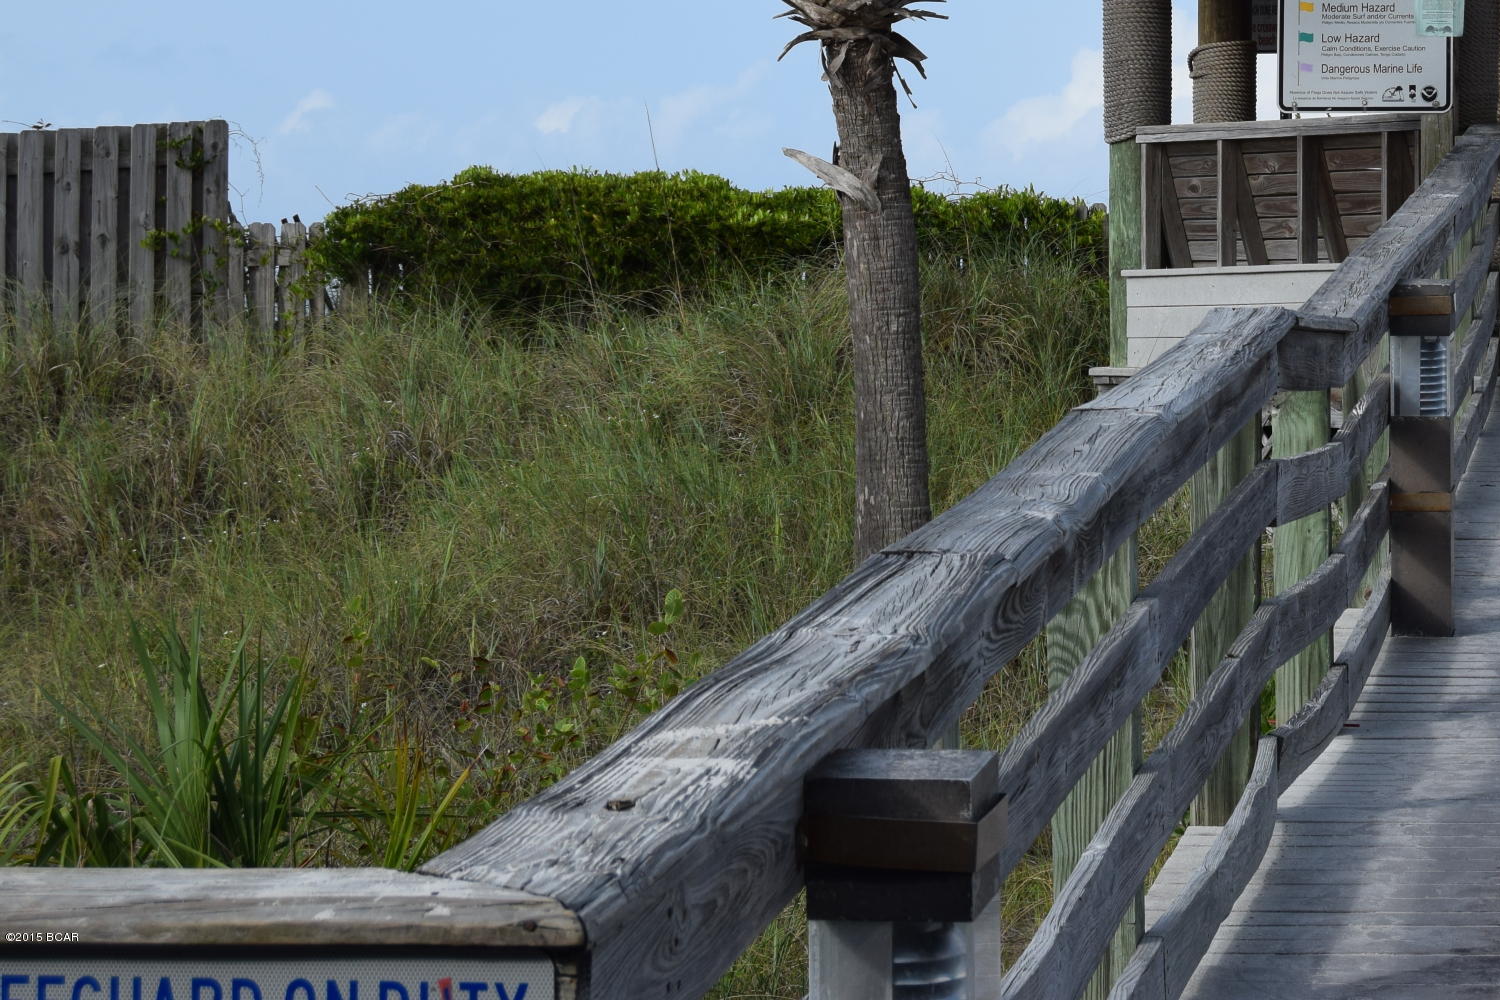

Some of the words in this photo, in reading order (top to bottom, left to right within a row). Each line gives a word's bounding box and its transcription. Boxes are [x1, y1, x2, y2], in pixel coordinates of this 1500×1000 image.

[1321, 2, 1359, 13] Medium
[1361, 2, 1396, 13] Hazard
[1321, 33, 1342, 43] Low
[1344, 33, 1380, 43] Hazard
[1321, 63, 1370, 76] Dangerous
[1373, 63, 1404, 74] Marine
[1406, 63, 1423, 74] Life
